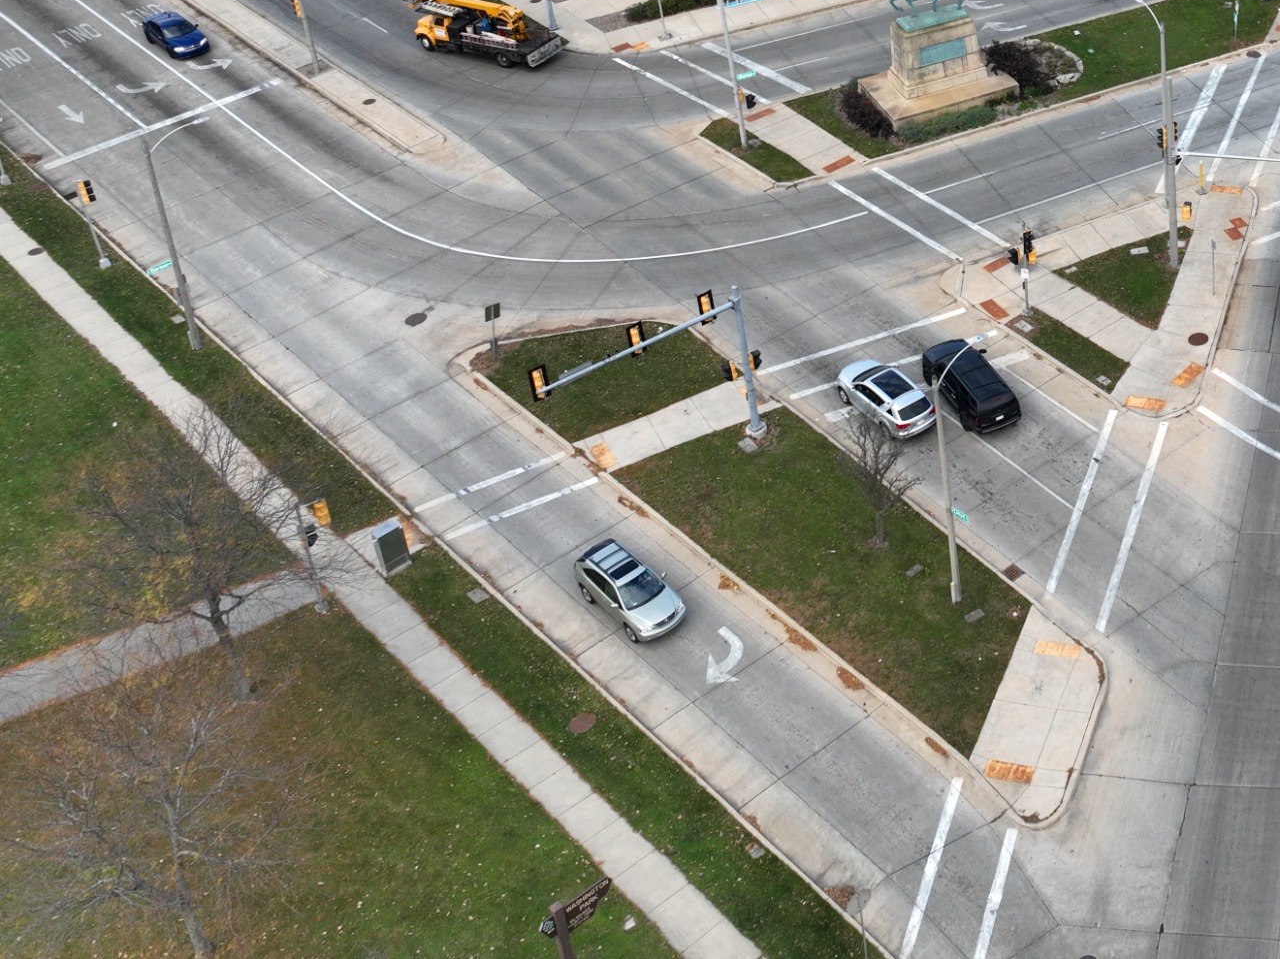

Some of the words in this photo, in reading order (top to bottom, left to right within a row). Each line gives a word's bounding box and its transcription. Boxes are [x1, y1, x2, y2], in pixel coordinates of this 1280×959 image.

[53, 23, 103, 48] ONLY
[565, 879, 609, 913] WASHINGTON
[579, 894, 598, 911] PARK
